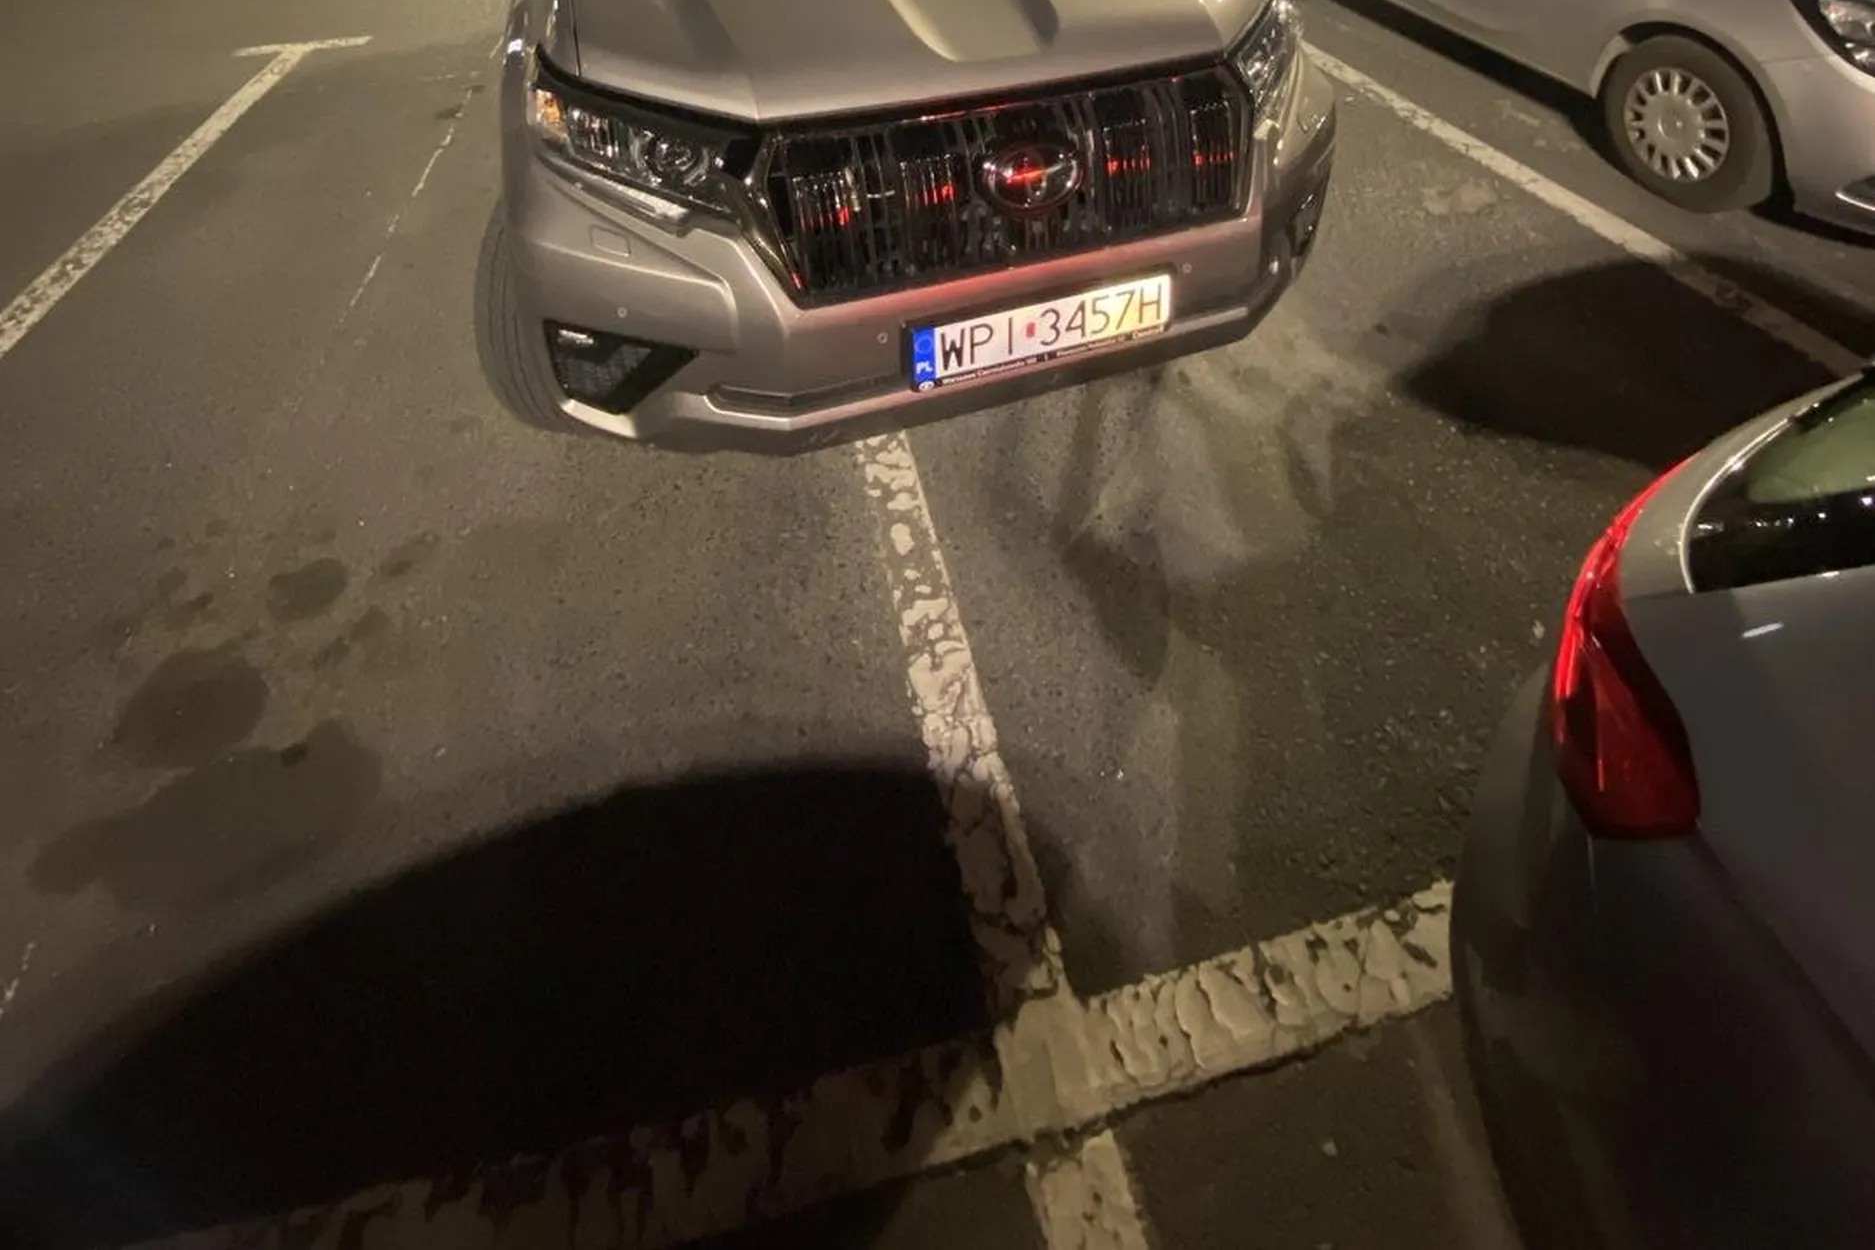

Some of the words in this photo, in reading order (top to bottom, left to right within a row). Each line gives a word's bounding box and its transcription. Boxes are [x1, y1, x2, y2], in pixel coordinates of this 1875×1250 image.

[941, 317, 1013, 372] WPI
[1040, 283, 1162, 347] 3457H
[915, 360, 933, 375] PL
